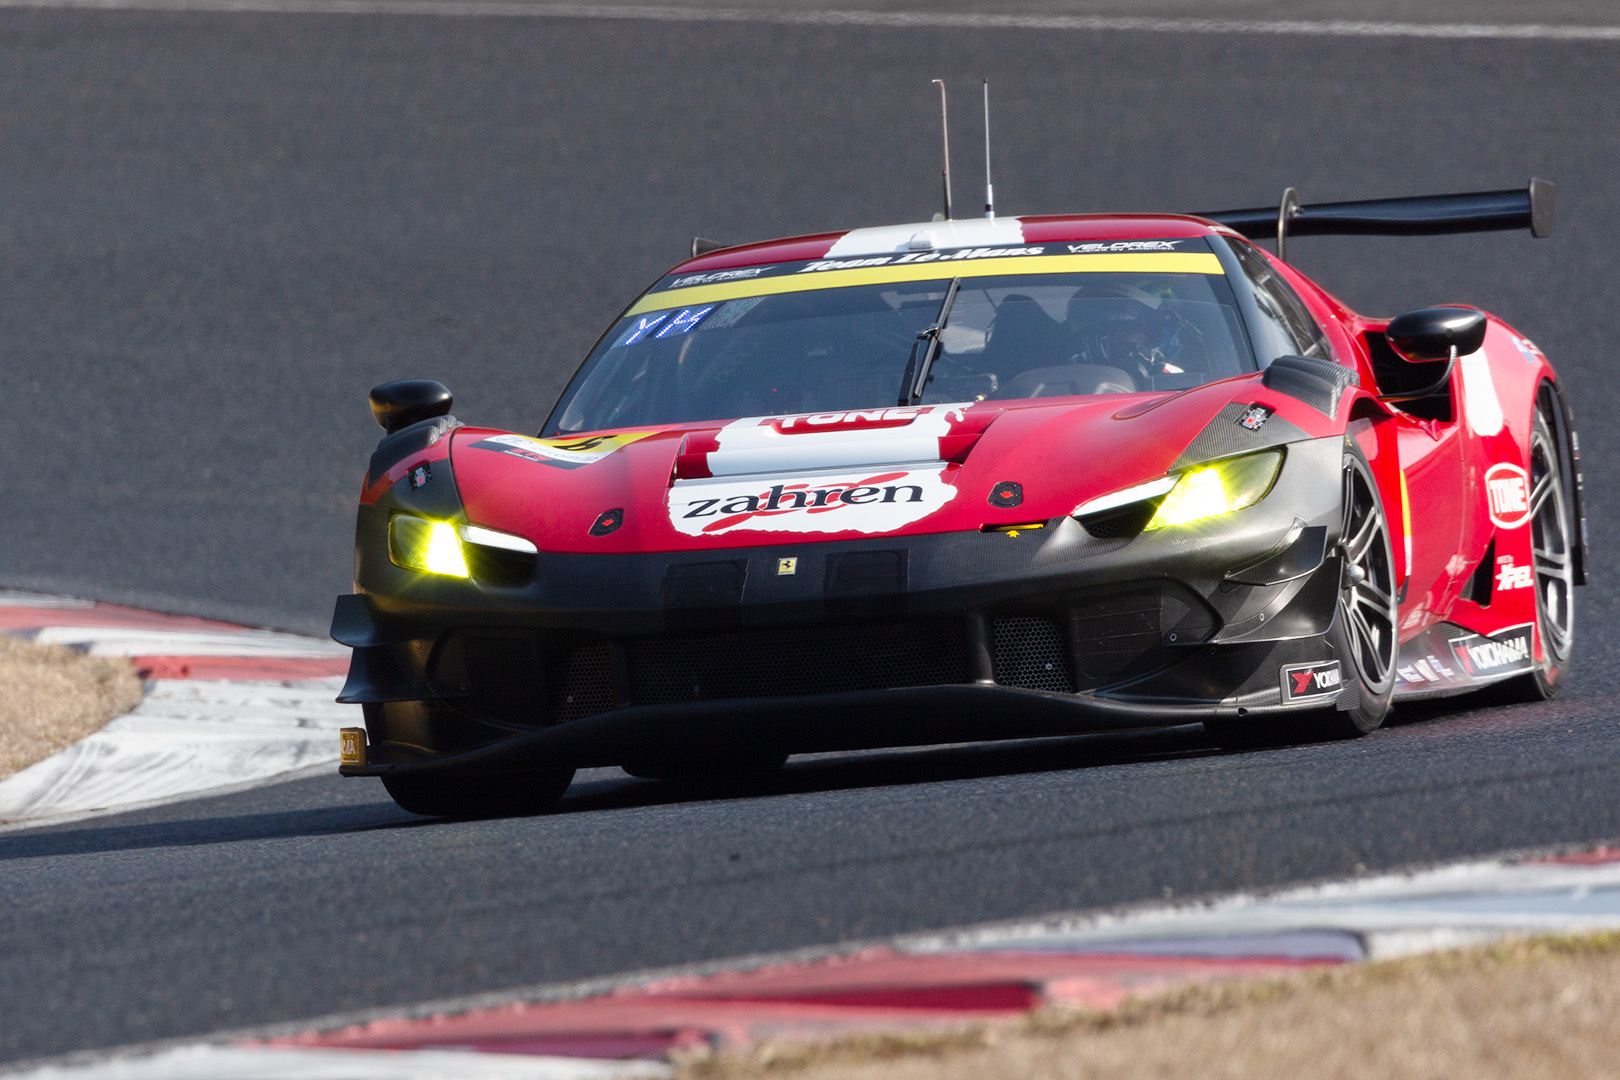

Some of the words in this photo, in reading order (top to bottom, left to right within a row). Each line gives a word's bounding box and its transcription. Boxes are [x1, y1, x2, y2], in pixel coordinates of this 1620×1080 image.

[1067, 240, 1184, 251] VELOREX
[797, 256, 893, 274] Team
[776, 407, 923, 429] TONE
[682, 484, 924, 519] zahren
[1489, 477, 1527, 514] TONE
